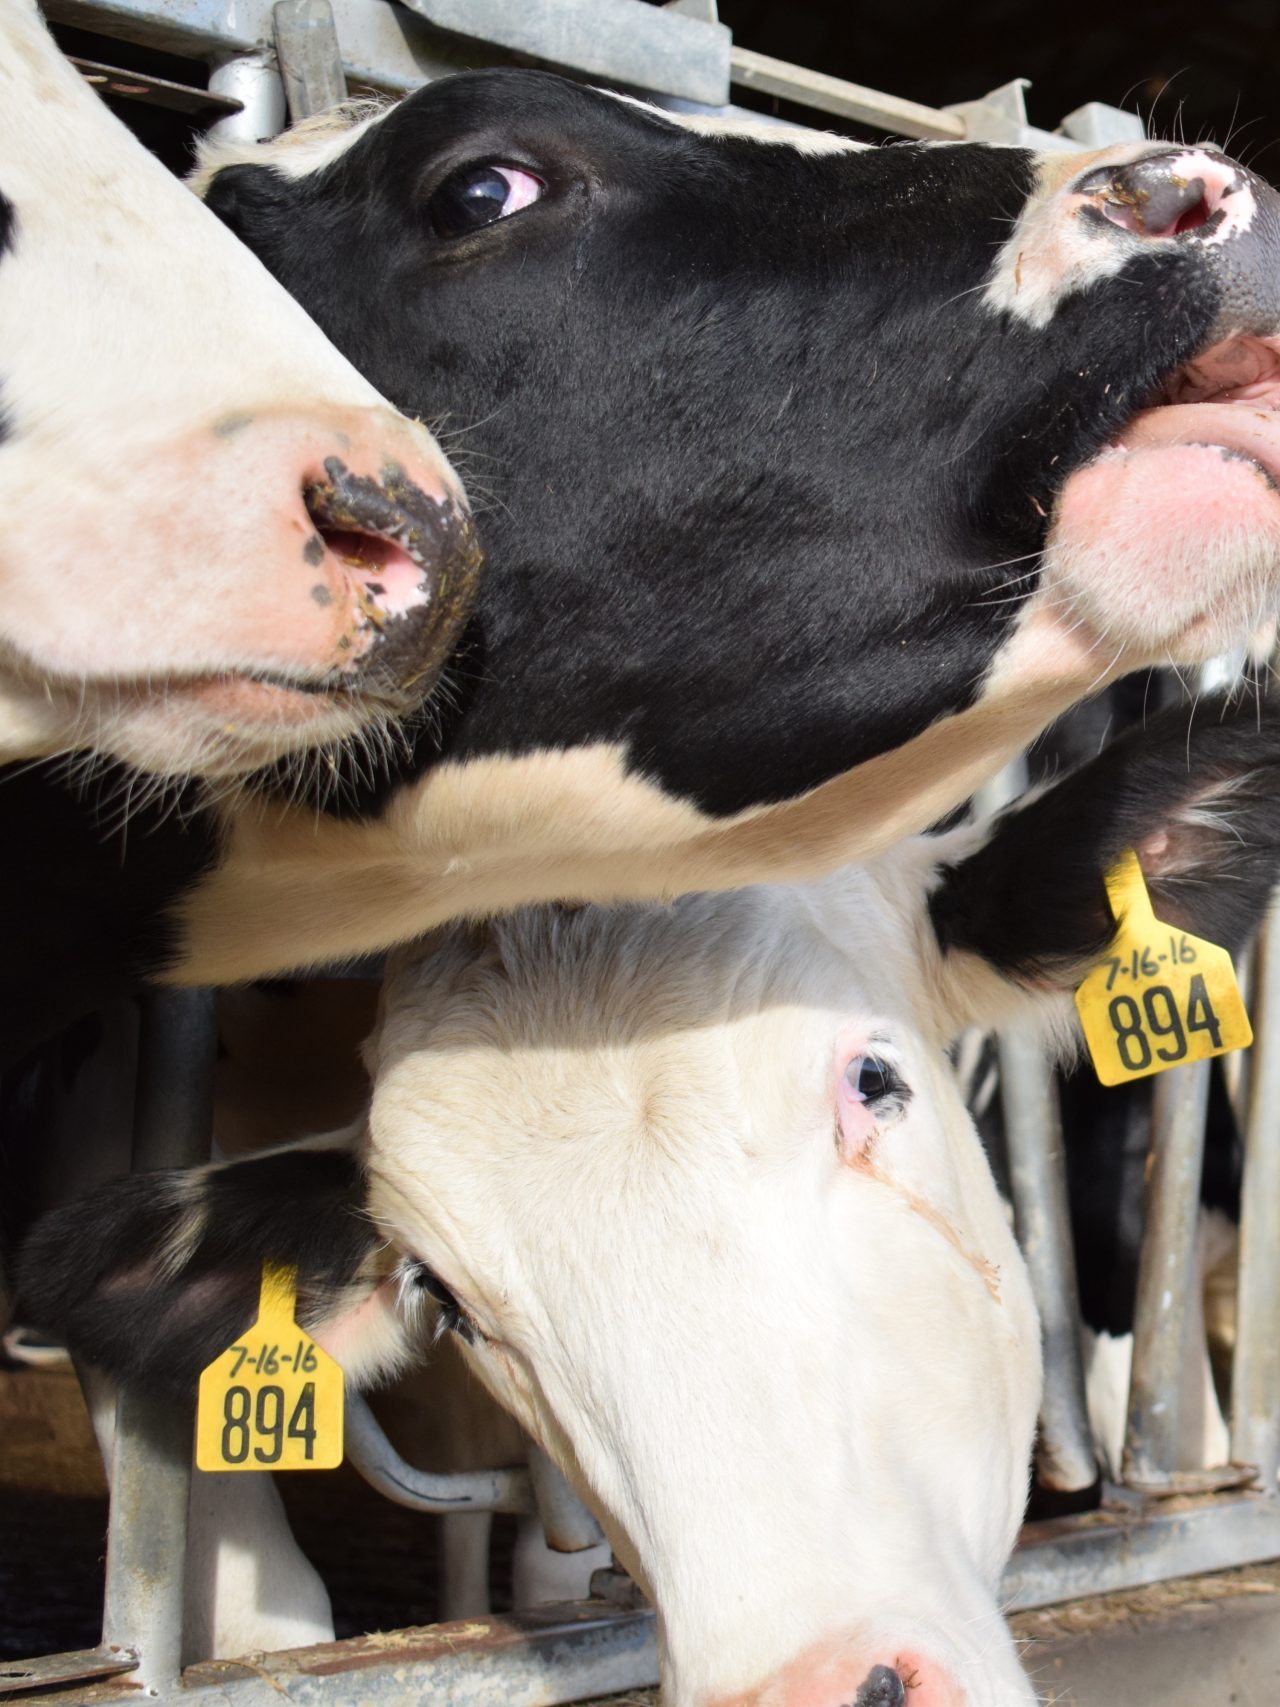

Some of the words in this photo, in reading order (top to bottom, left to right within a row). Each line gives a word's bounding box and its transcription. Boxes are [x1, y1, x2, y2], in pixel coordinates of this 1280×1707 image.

[1105, 935, 1197, 991] 7-16-16
[1108, 973, 1223, 1071] 894
[229, 1340, 318, 1379] 7-16-16
[221, 1382, 317, 1464] 894
